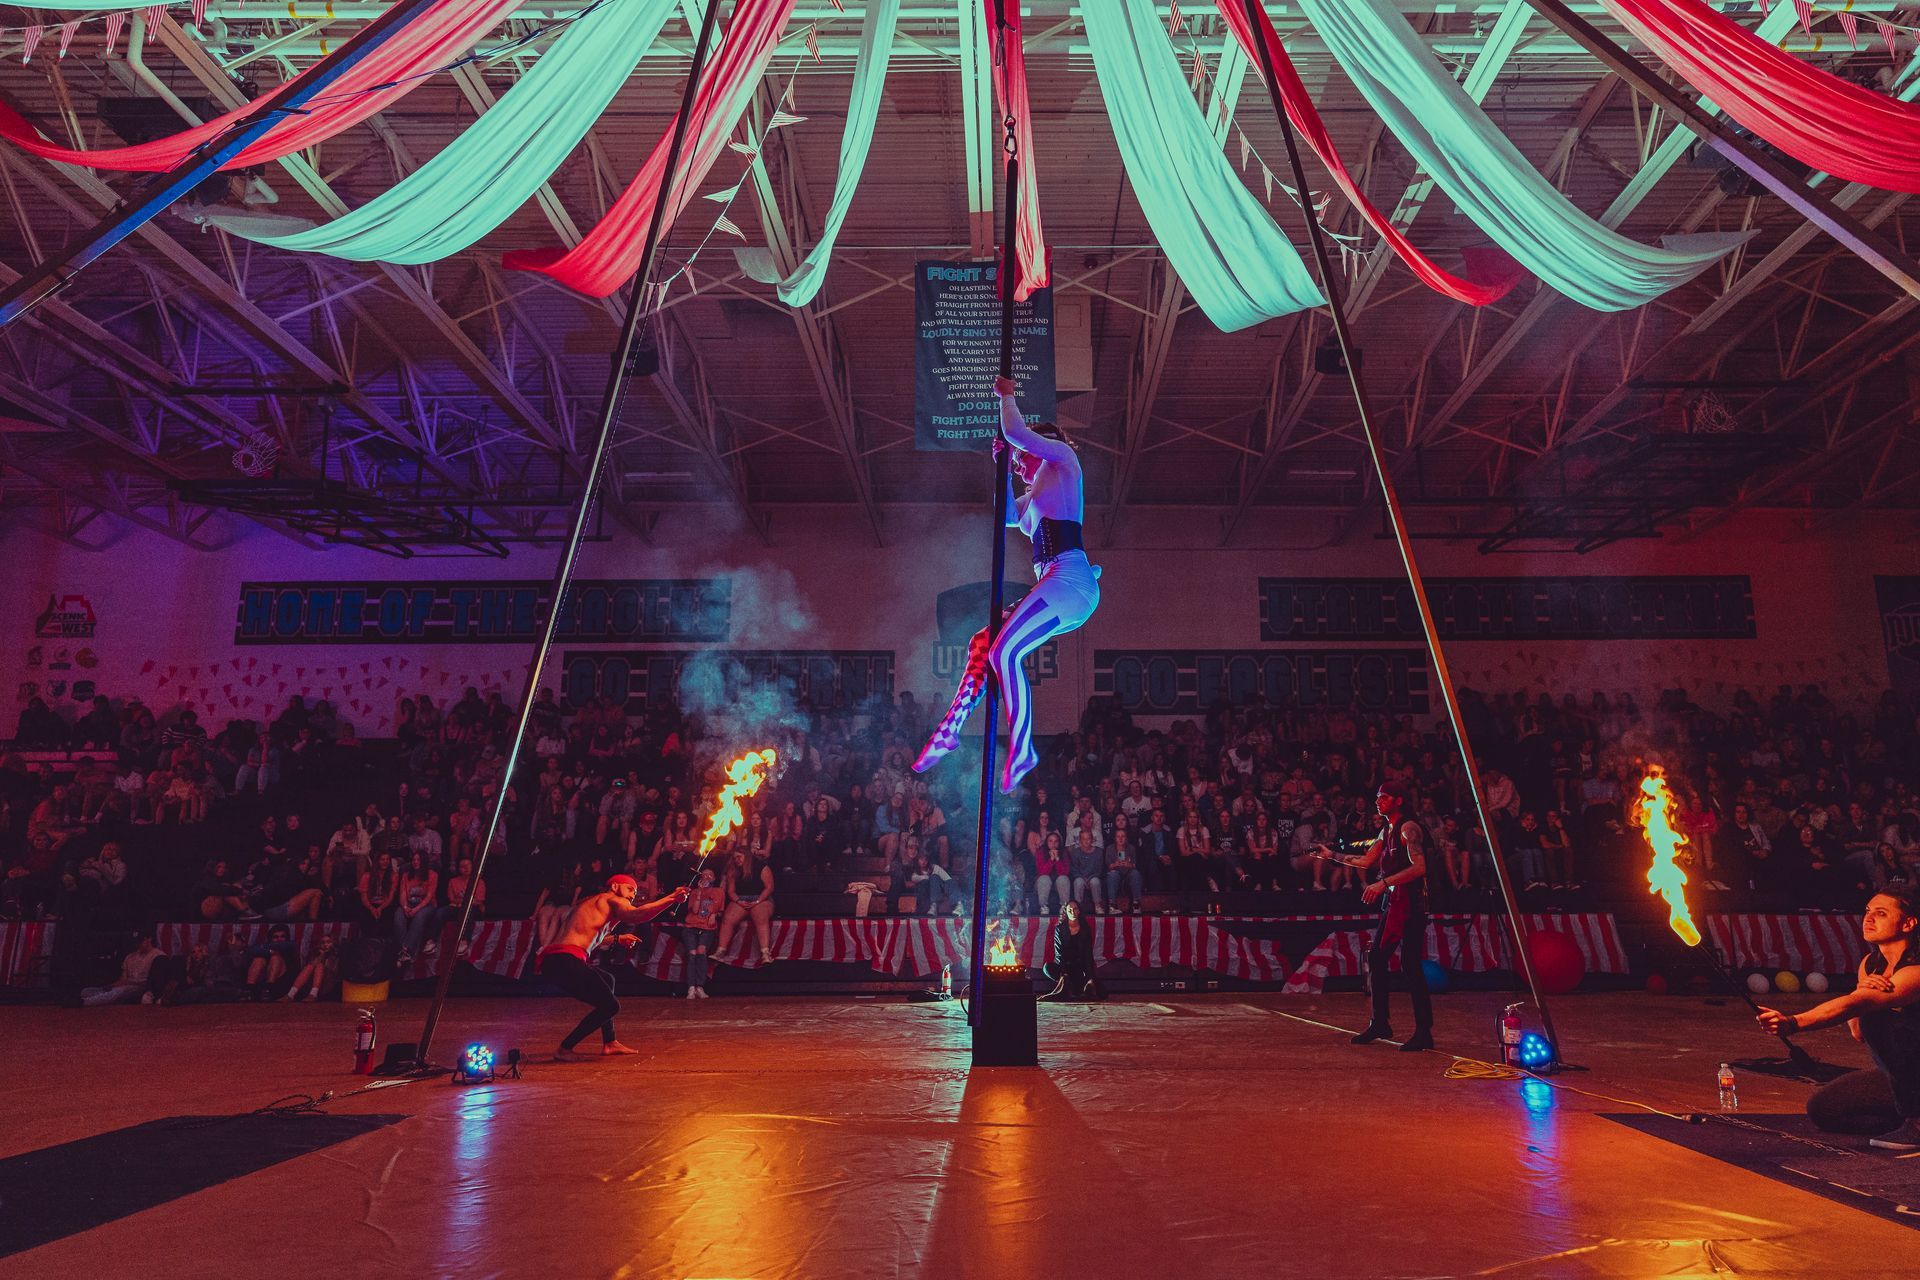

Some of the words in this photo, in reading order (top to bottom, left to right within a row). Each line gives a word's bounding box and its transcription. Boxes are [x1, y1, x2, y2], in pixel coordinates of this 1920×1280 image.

[927, 267, 981, 282] FIGHT
[936, 301, 969, 309] STRAIGHT
[923, 327, 960, 339] LOUDLY
[963, 328, 986, 337] SING
[1019, 327, 1047, 336] NAME
[952, 374, 974, 382] KNOW
[949, 383, 968, 391] FIGHT
[947, 392, 975, 400] ALWAYS
[958, 402, 974, 412] DO
[976, 401, 992, 410] OR
[932, 415, 964, 425] FIGHT
[966, 414, 999, 425] EAGLE
[937, 429, 970, 439] FIGHT
[240, 588, 367, 637] HOME
[378, 588, 436, 636] OF
[449, 587, 539, 636] THE
[567, 656, 631, 708] GO
[1112, 655, 1178, 709] GO
